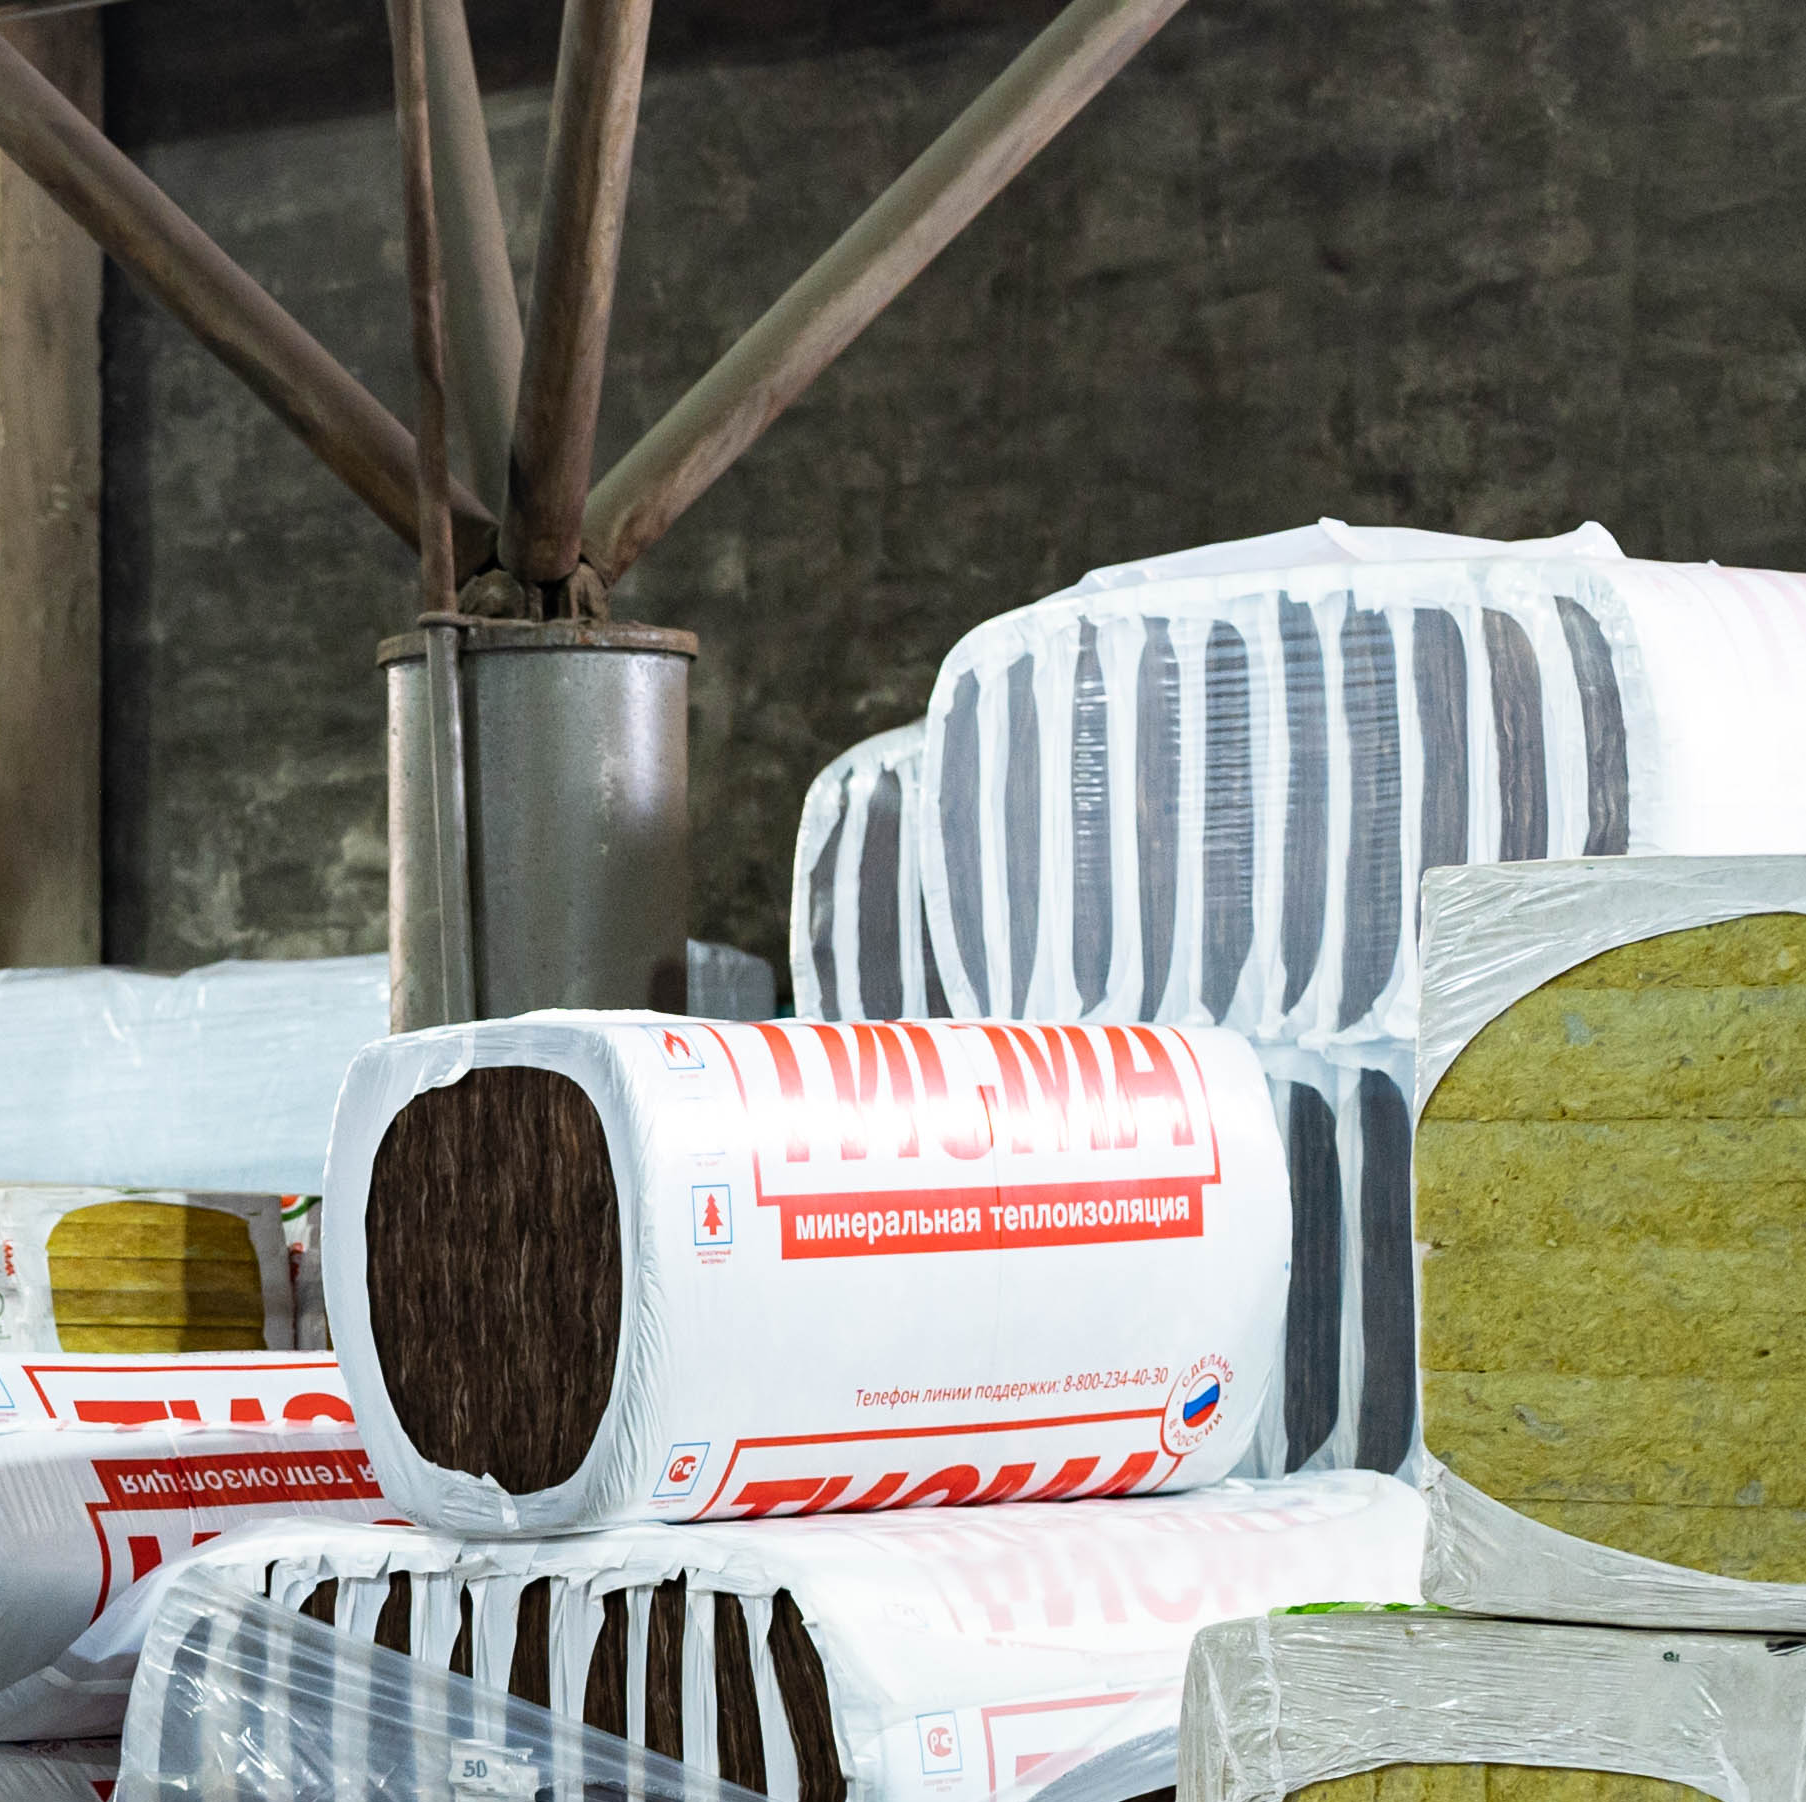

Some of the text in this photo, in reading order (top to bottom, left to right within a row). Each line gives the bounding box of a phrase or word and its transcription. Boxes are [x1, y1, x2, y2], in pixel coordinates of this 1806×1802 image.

[794, 1192, 1192, 1245] минеральная теплоизоляция
[854, 1366, 1169, 1409] Телефон линии поддержки: 8-800-234-40-30
[462, 1759, 488, 1778] 50
